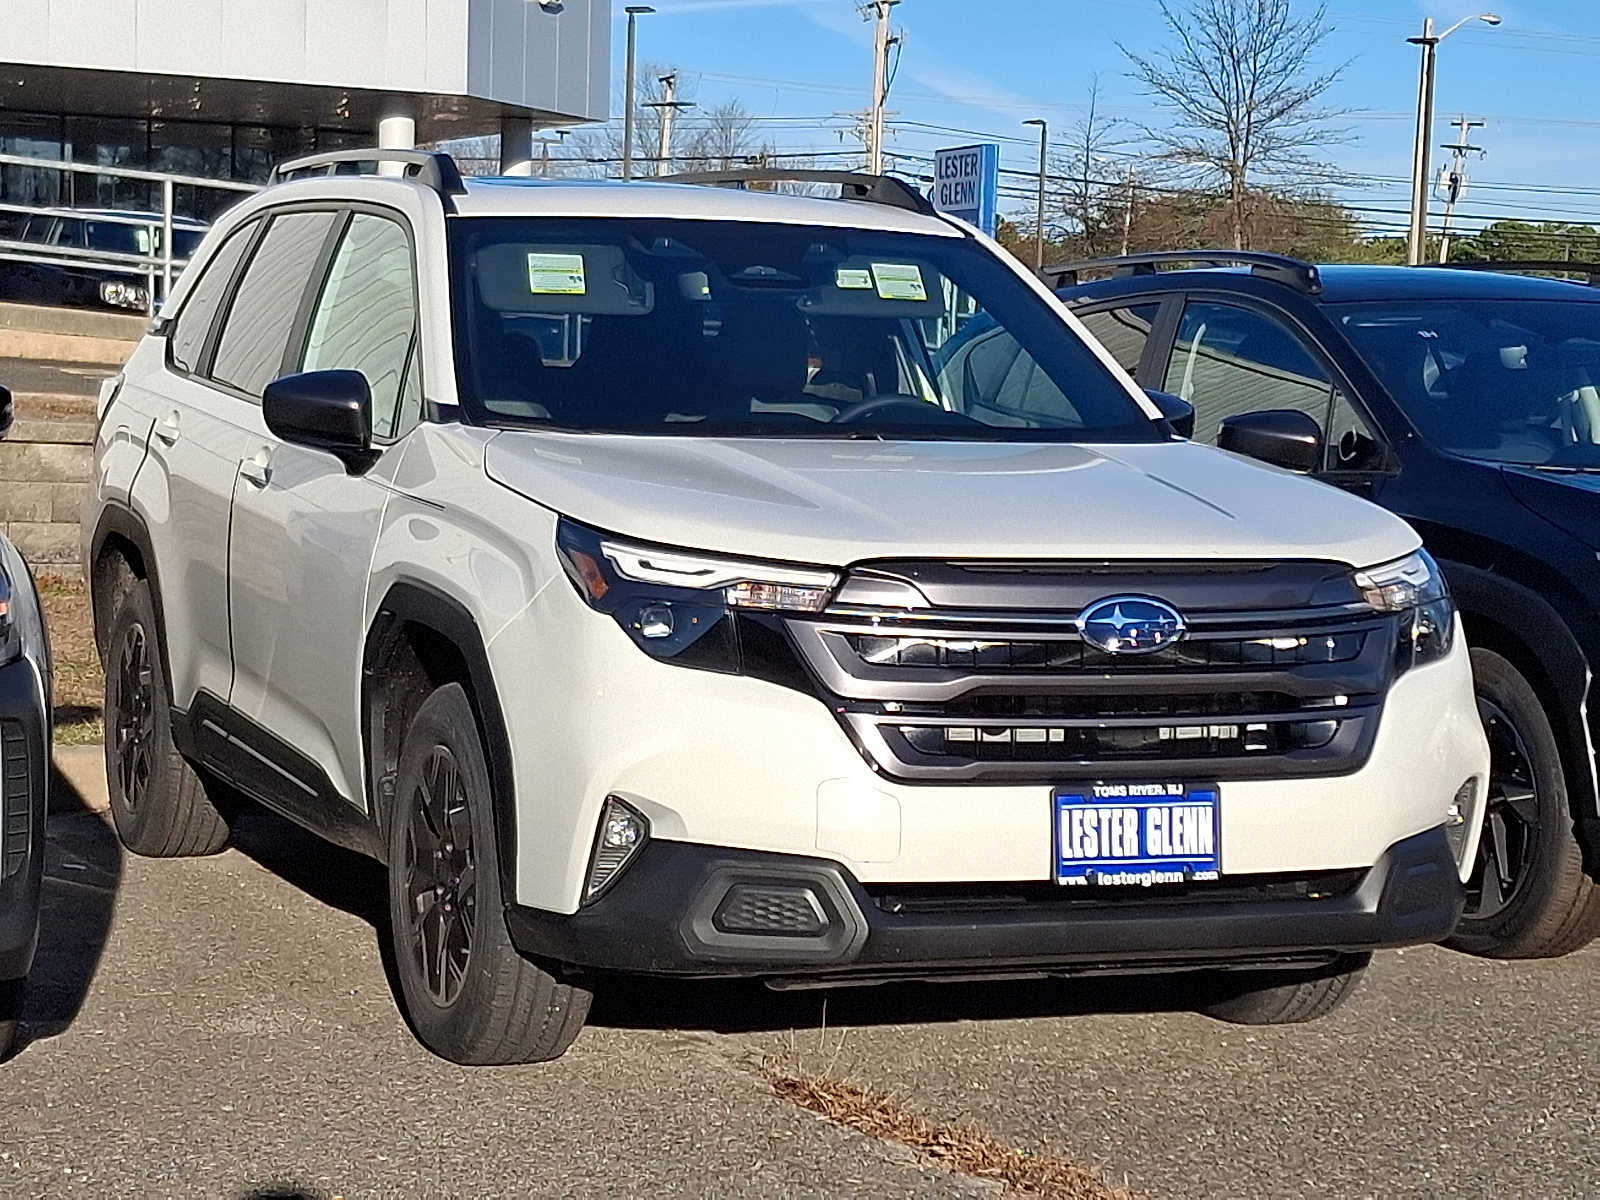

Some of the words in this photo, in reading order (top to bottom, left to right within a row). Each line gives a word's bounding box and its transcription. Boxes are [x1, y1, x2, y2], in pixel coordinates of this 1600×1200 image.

[938, 153, 978, 180] LESTER
[940, 181, 976, 206] GLENN
[1093, 785, 1127, 798] TOMS
[1061, 807, 1139, 859] LESTER
[1146, 806, 1214, 856] GLENN
